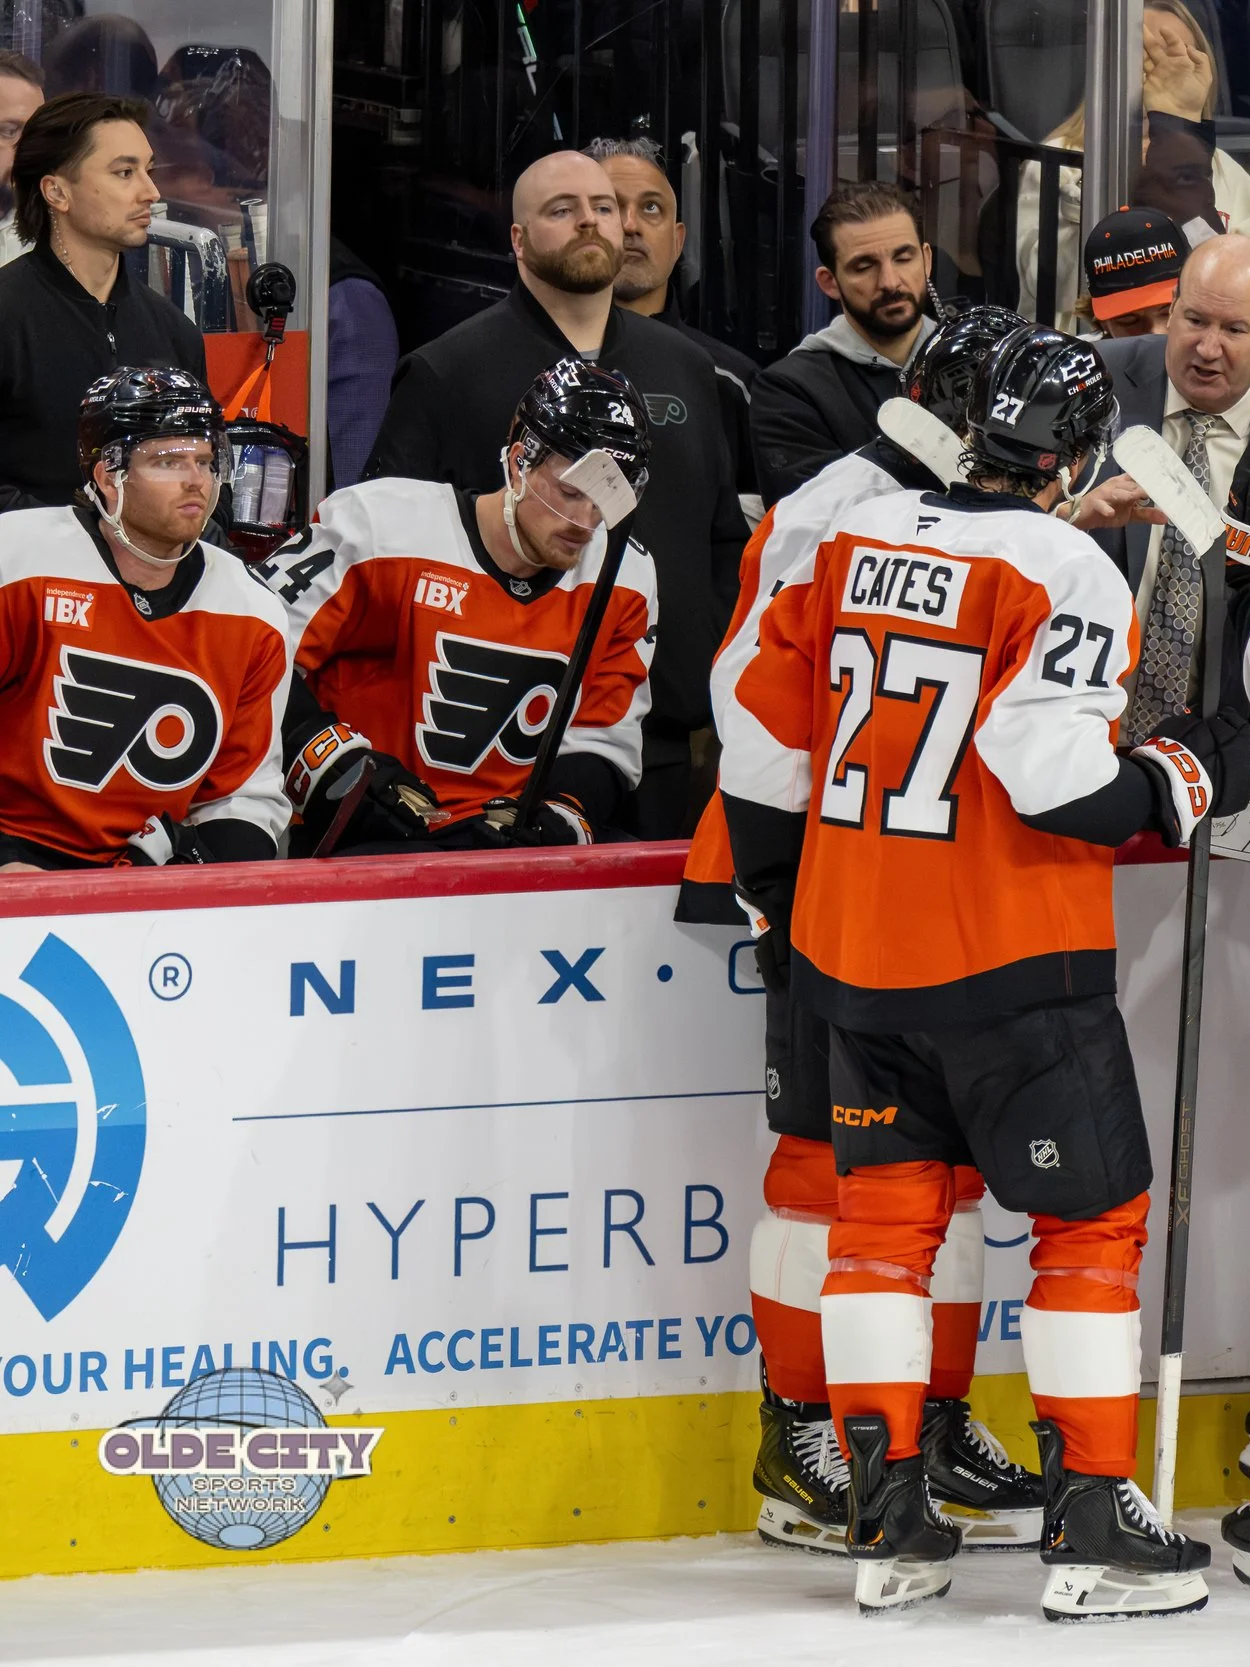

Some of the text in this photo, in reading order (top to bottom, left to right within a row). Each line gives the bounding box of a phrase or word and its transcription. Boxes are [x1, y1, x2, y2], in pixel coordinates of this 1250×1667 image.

[1093, 242, 1177, 275] PHILADELPHIA
[176, 406, 213, 415] BAUER
[608, 401, 635, 427] 24
[991, 392, 1025, 426] 27
[46, 588, 86, 599] Independence
[421, 571, 463, 587] Independence
[850, 556, 953, 617] CATES
[44, 597, 93, 627] IBX
[413, 578, 470, 616] IBX
[1041, 613, 1114, 688] 27
[819, 625, 989, 842] 27
[832, 1104, 898, 1128] CCM
[277, 1184, 730, 1286] HYPERB
[0, 1351, 108, 1397] OUR
[384, 1317, 683, 1376] ACCELERATE
[695, 1313, 758, 1357] YO
[782, 1474, 814, 1505] BAUER
[952, 1466, 999, 1491] BAUER
